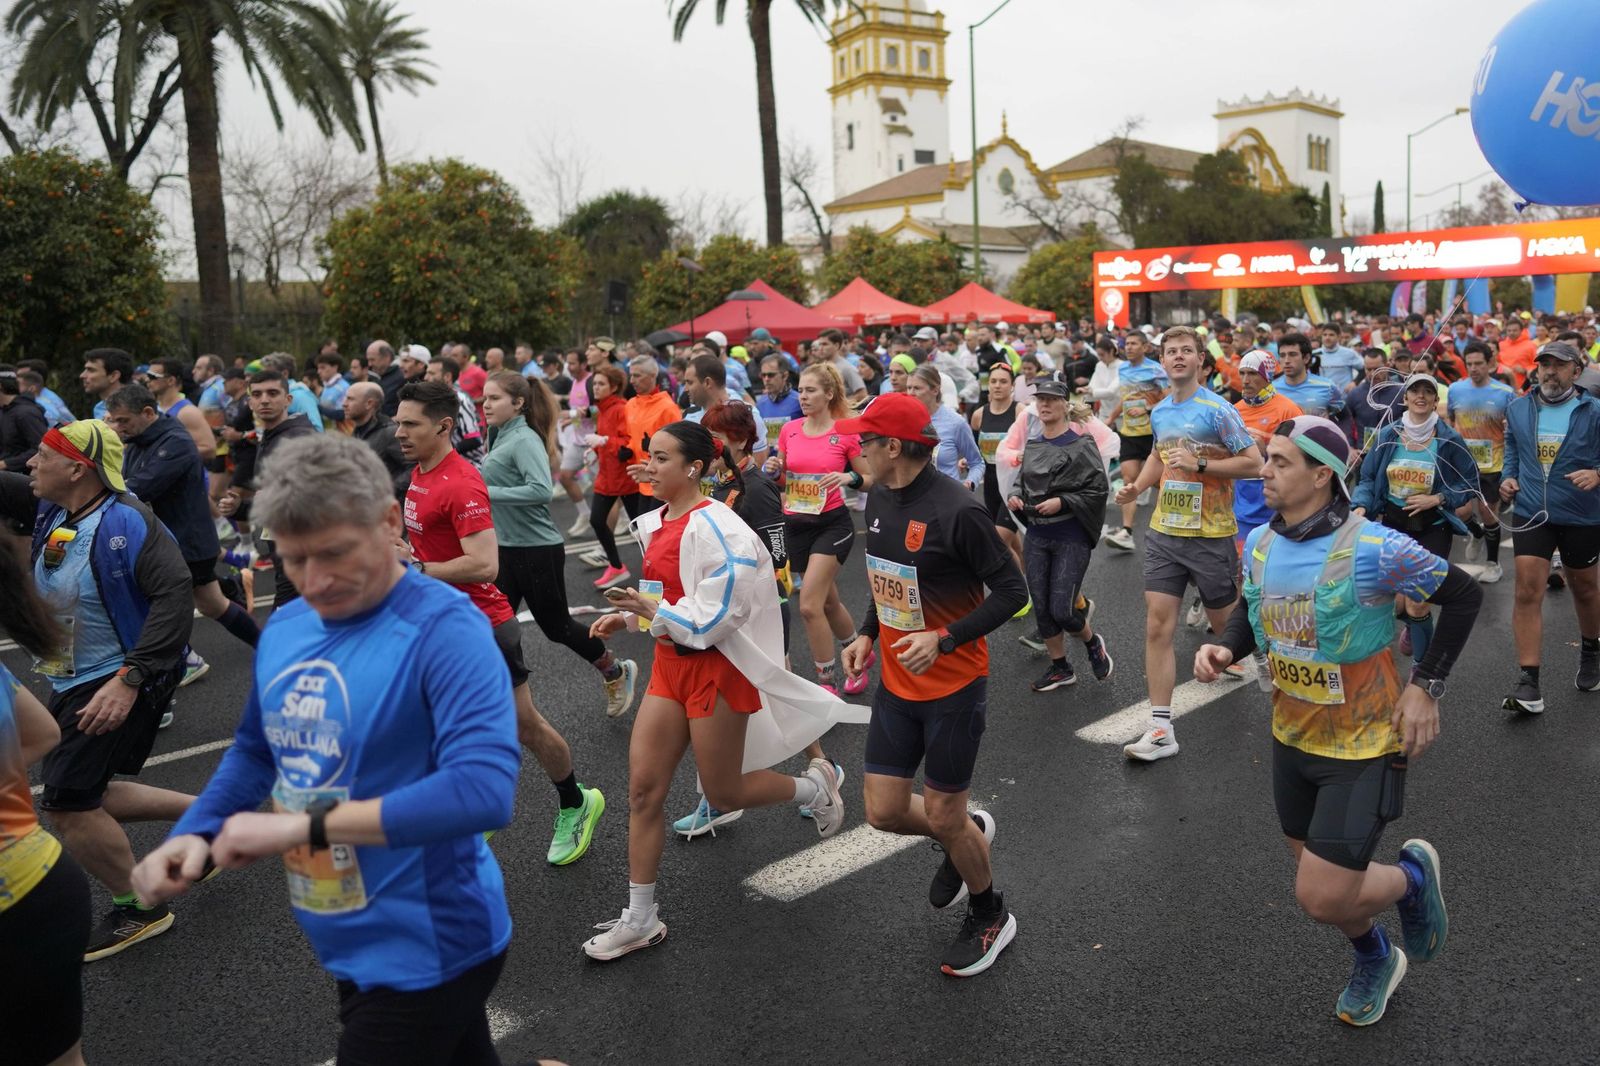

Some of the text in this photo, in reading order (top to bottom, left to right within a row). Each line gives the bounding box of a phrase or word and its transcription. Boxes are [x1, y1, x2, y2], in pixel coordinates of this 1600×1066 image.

[1390, 468, 1426, 485] 16026
[790, 482, 819, 497] 14430
[1162, 491, 1194, 508] 10187
[873, 574, 904, 601] 5759
[1271, 656, 1328, 688] 18934
